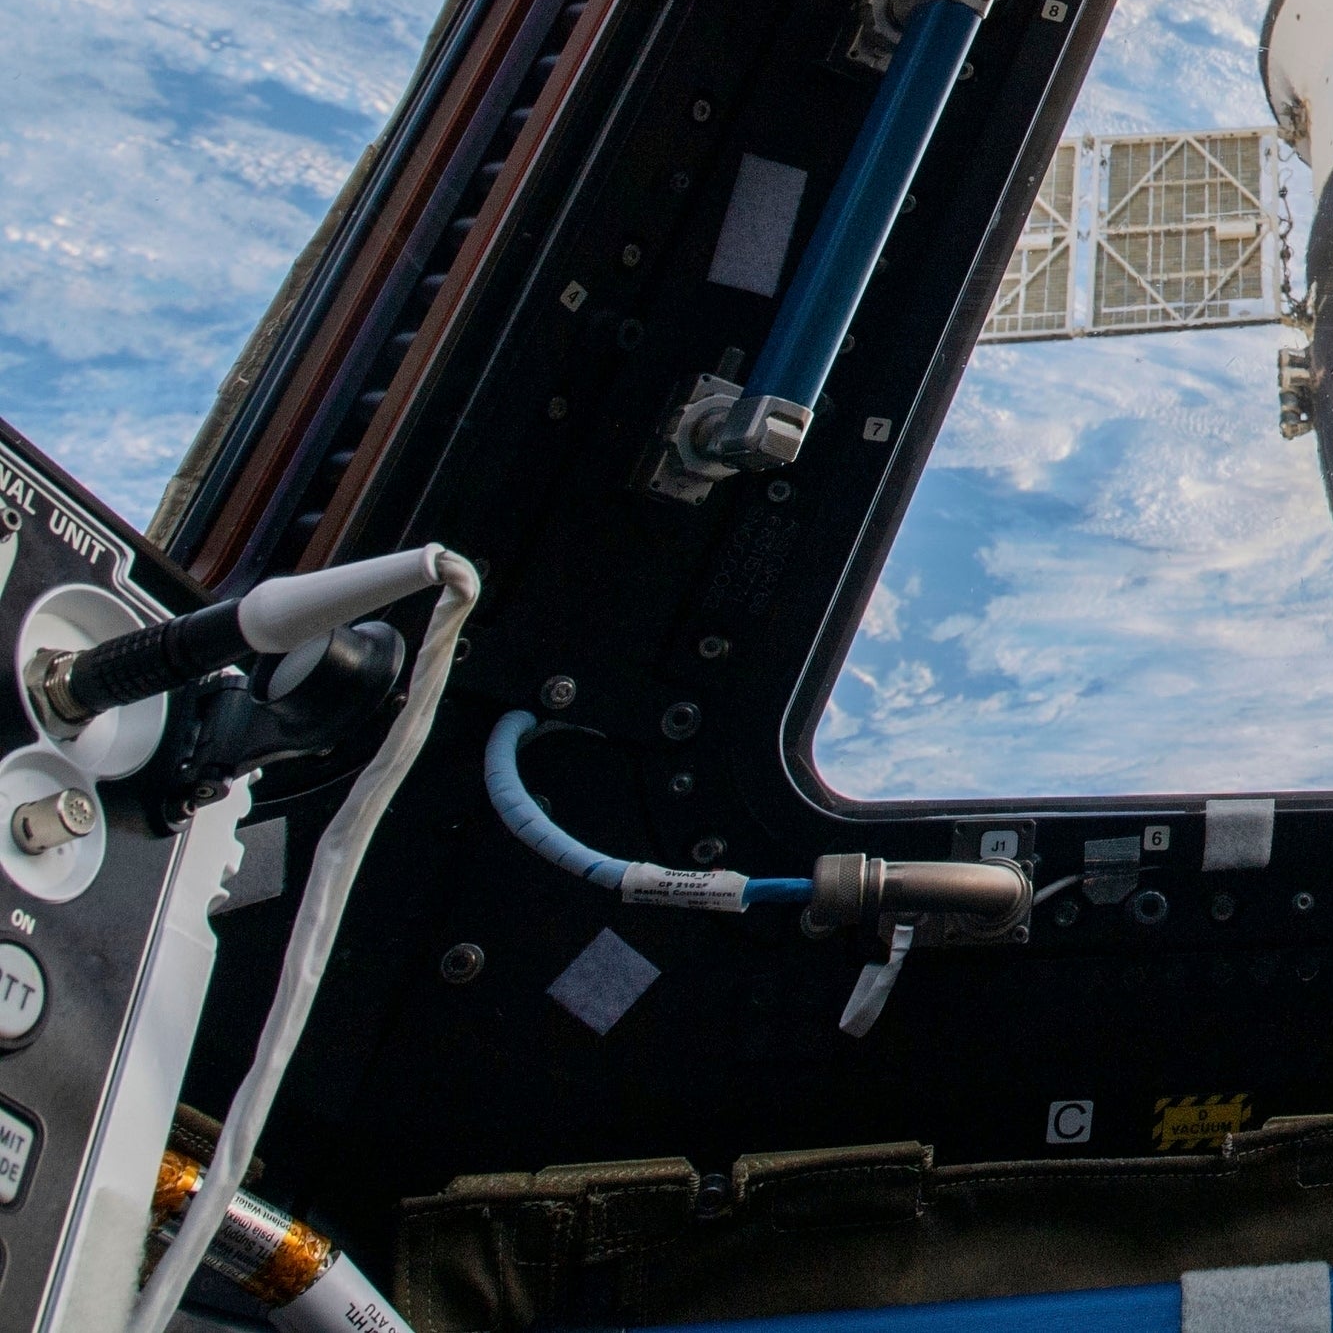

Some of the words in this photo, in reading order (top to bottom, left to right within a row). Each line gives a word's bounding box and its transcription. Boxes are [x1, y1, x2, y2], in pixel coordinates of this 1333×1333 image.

[1048, 4, 1059, 17] 8
[873, 422, 884, 437] 7
[49, 508, 106, 565] UNIT
[991, 840, 1006, 853] J1
[1152, 831, 1162, 846] 6
[11, 907, 36, 935] ON
[1054, 1103, 1086, 1139] C
[1199, 1109, 1208, 1121] D
[1171, 1121, 1233, 1135] VACUUM
[235, 1196, 261, 1216] Water
[222, 1225, 256, 1252] Supply
[252, 1226, 276, 1244] psia
[345, 1302, 368, 1331] HTL
[364, 1303, 389, 1328] ATU
